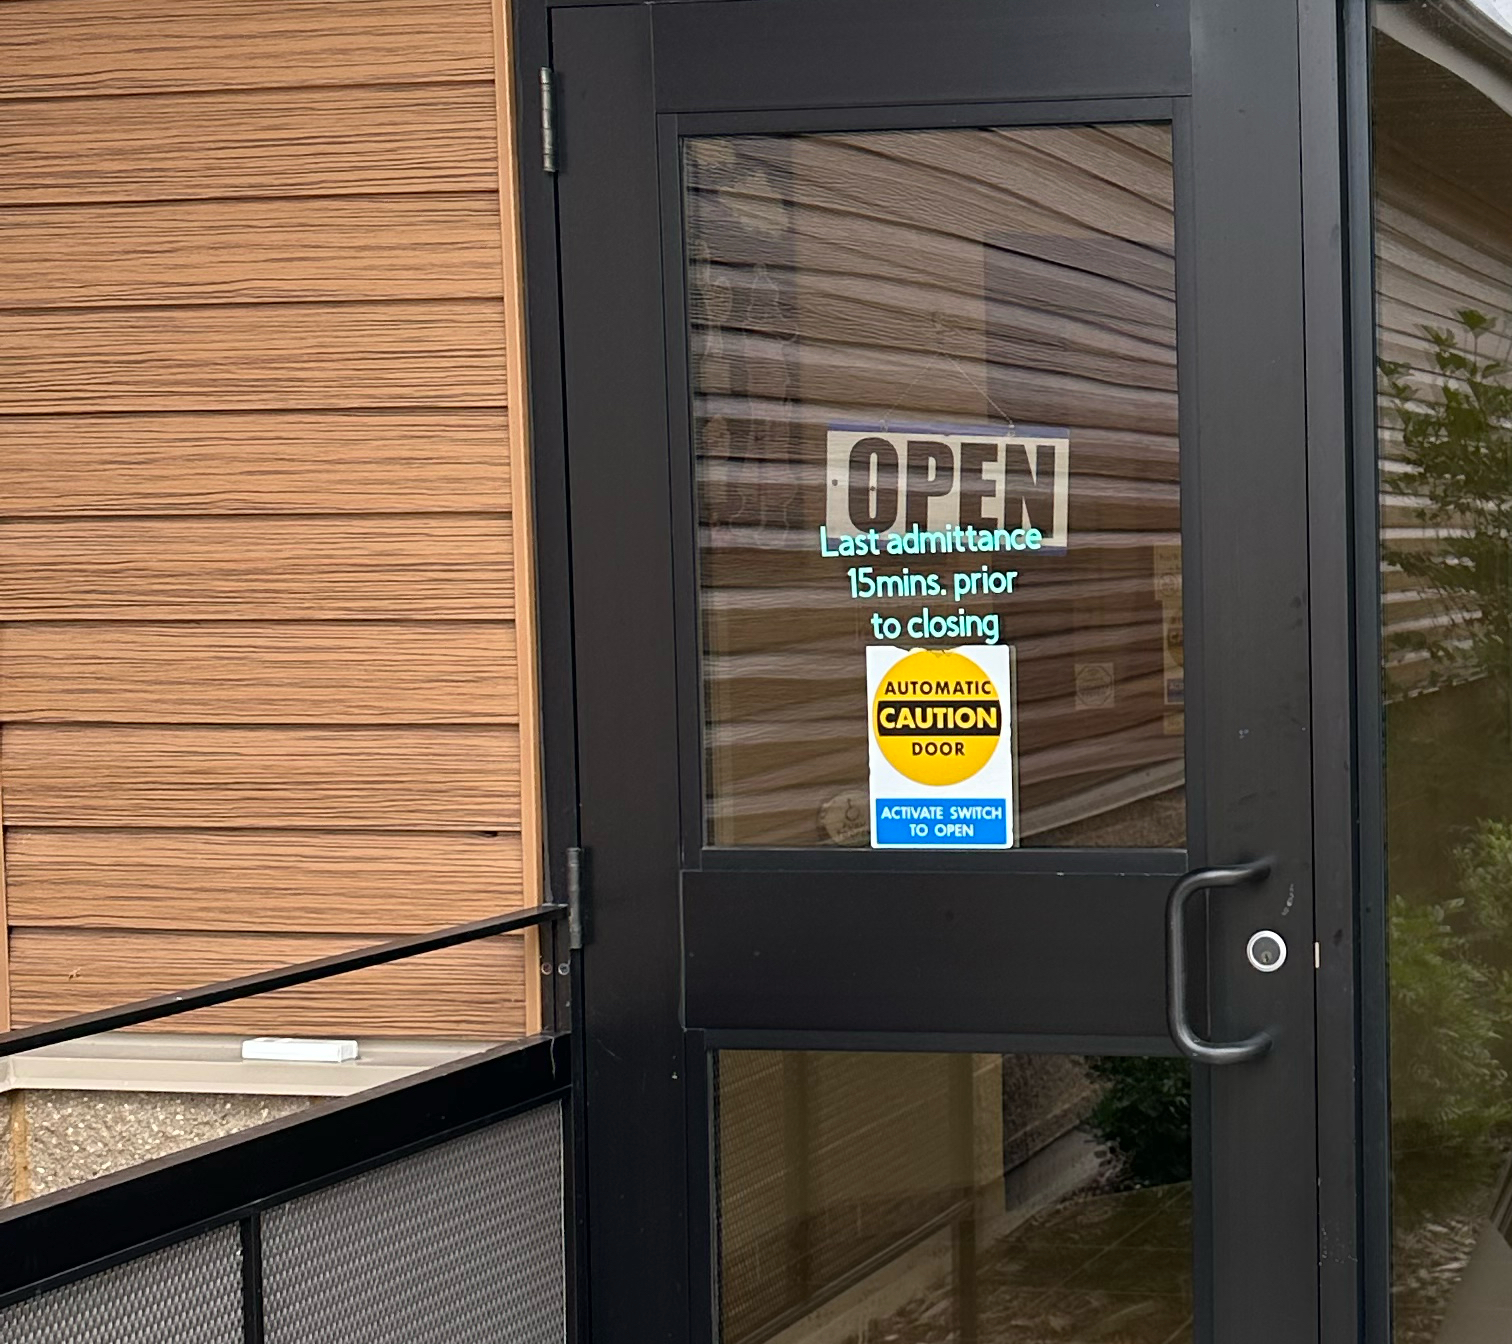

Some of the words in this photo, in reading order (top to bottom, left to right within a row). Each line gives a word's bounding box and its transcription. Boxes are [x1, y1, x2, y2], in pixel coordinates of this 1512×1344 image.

[847, 437, 1057, 541] OPEN
[820, 525, 881, 558] Last
[887, 522, 1042, 555] admittance
[953, 566, 1018, 601] prior
[871, 612, 901, 640] to
[906, 608, 1000, 645] closing
[884, 680, 992, 696] AUTOMATIC
[879, 706, 998, 730] CAUTION
[911, 741, 966, 757] DOOR
[881, 806, 944, 821] ACTIVATE
[949, 806, 1003, 821] SWITCH
[909, 823, 929, 838] TO
[934, 823, 974, 838] OPEN
